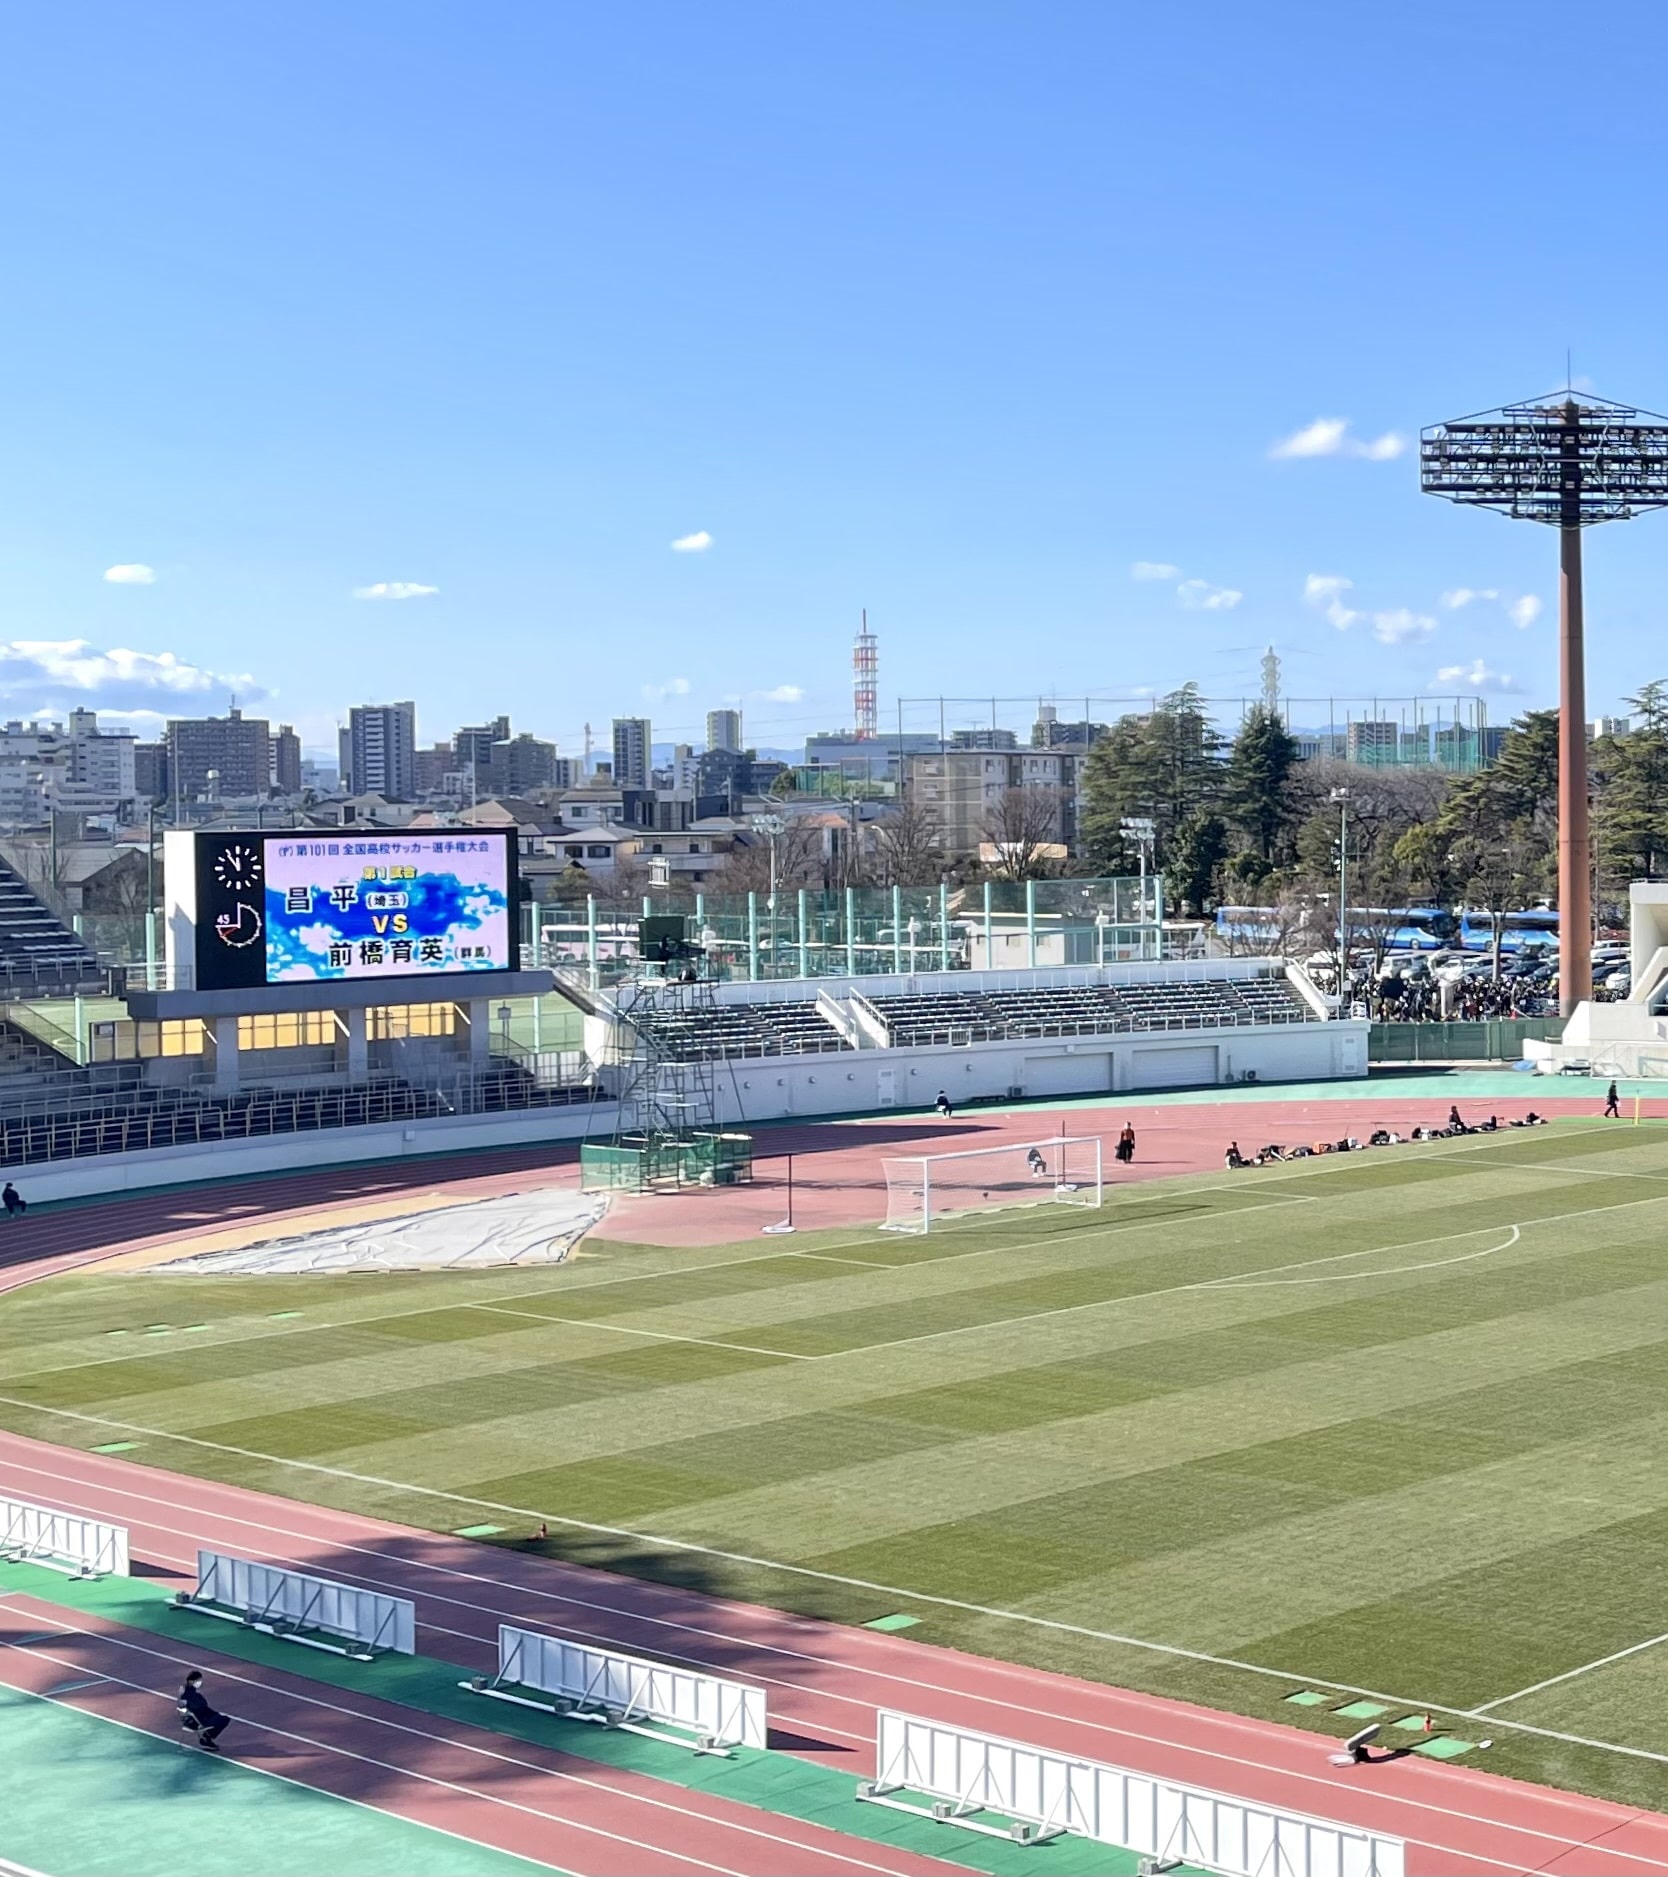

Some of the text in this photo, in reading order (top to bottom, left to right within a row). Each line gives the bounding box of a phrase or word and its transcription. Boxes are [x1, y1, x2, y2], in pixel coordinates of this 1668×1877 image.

[217, 914, 230, 925] 45
[329, 938, 443, 967] 前橋育英
